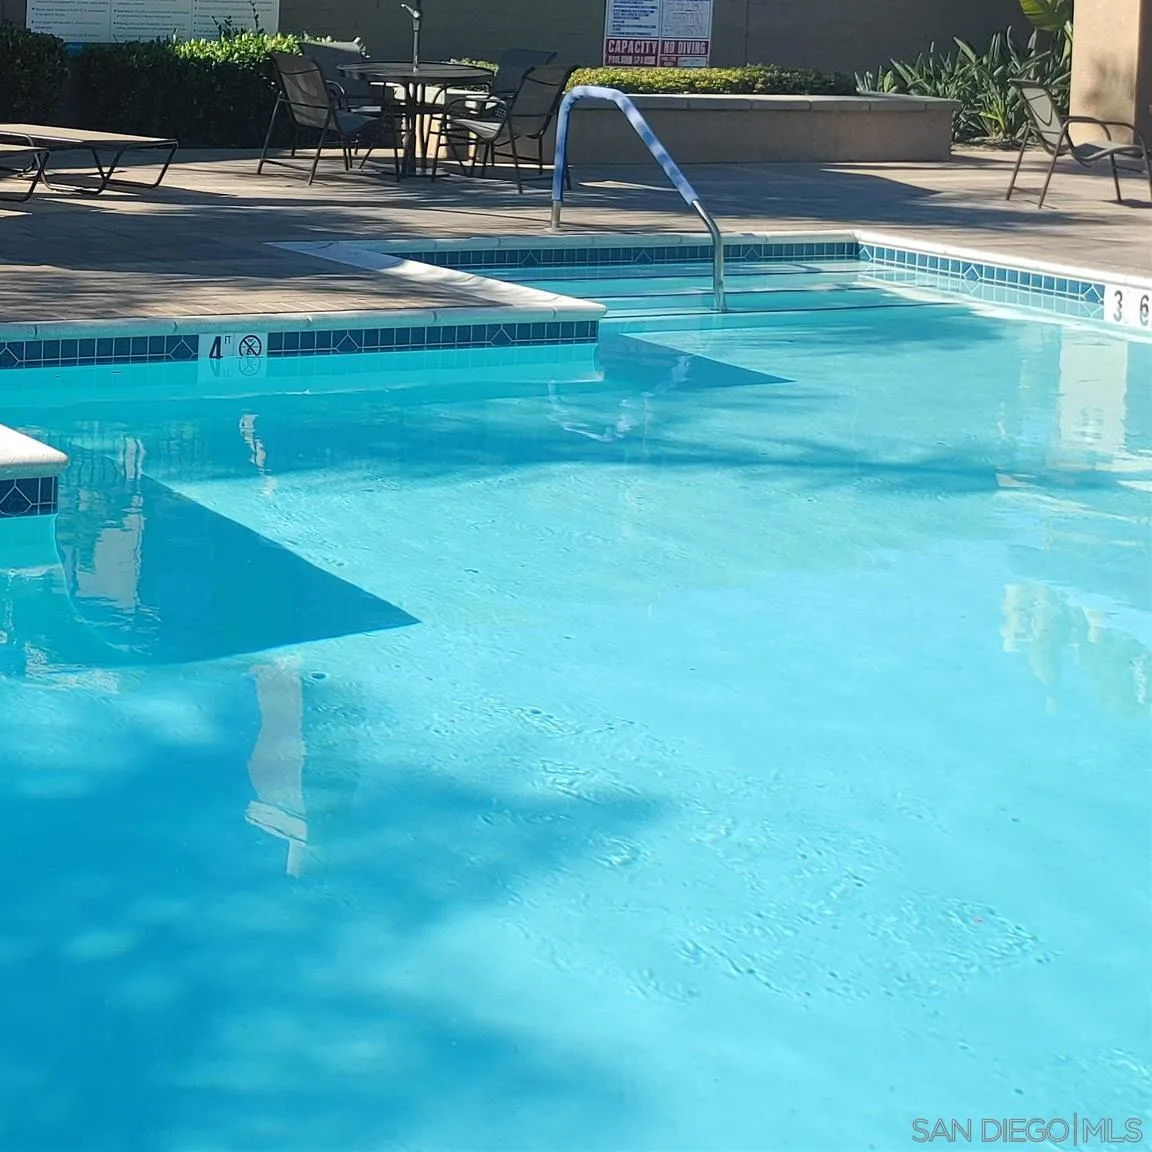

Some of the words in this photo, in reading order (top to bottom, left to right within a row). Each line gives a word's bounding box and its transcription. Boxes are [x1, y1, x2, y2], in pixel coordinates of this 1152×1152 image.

[608, 40, 658, 54] CAPACITY
[664, 41, 675, 54] NO
[677, 41, 706, 54] DIVING
[209, 336, 223, 359] 4
[224, 335, 232, 345] FT
